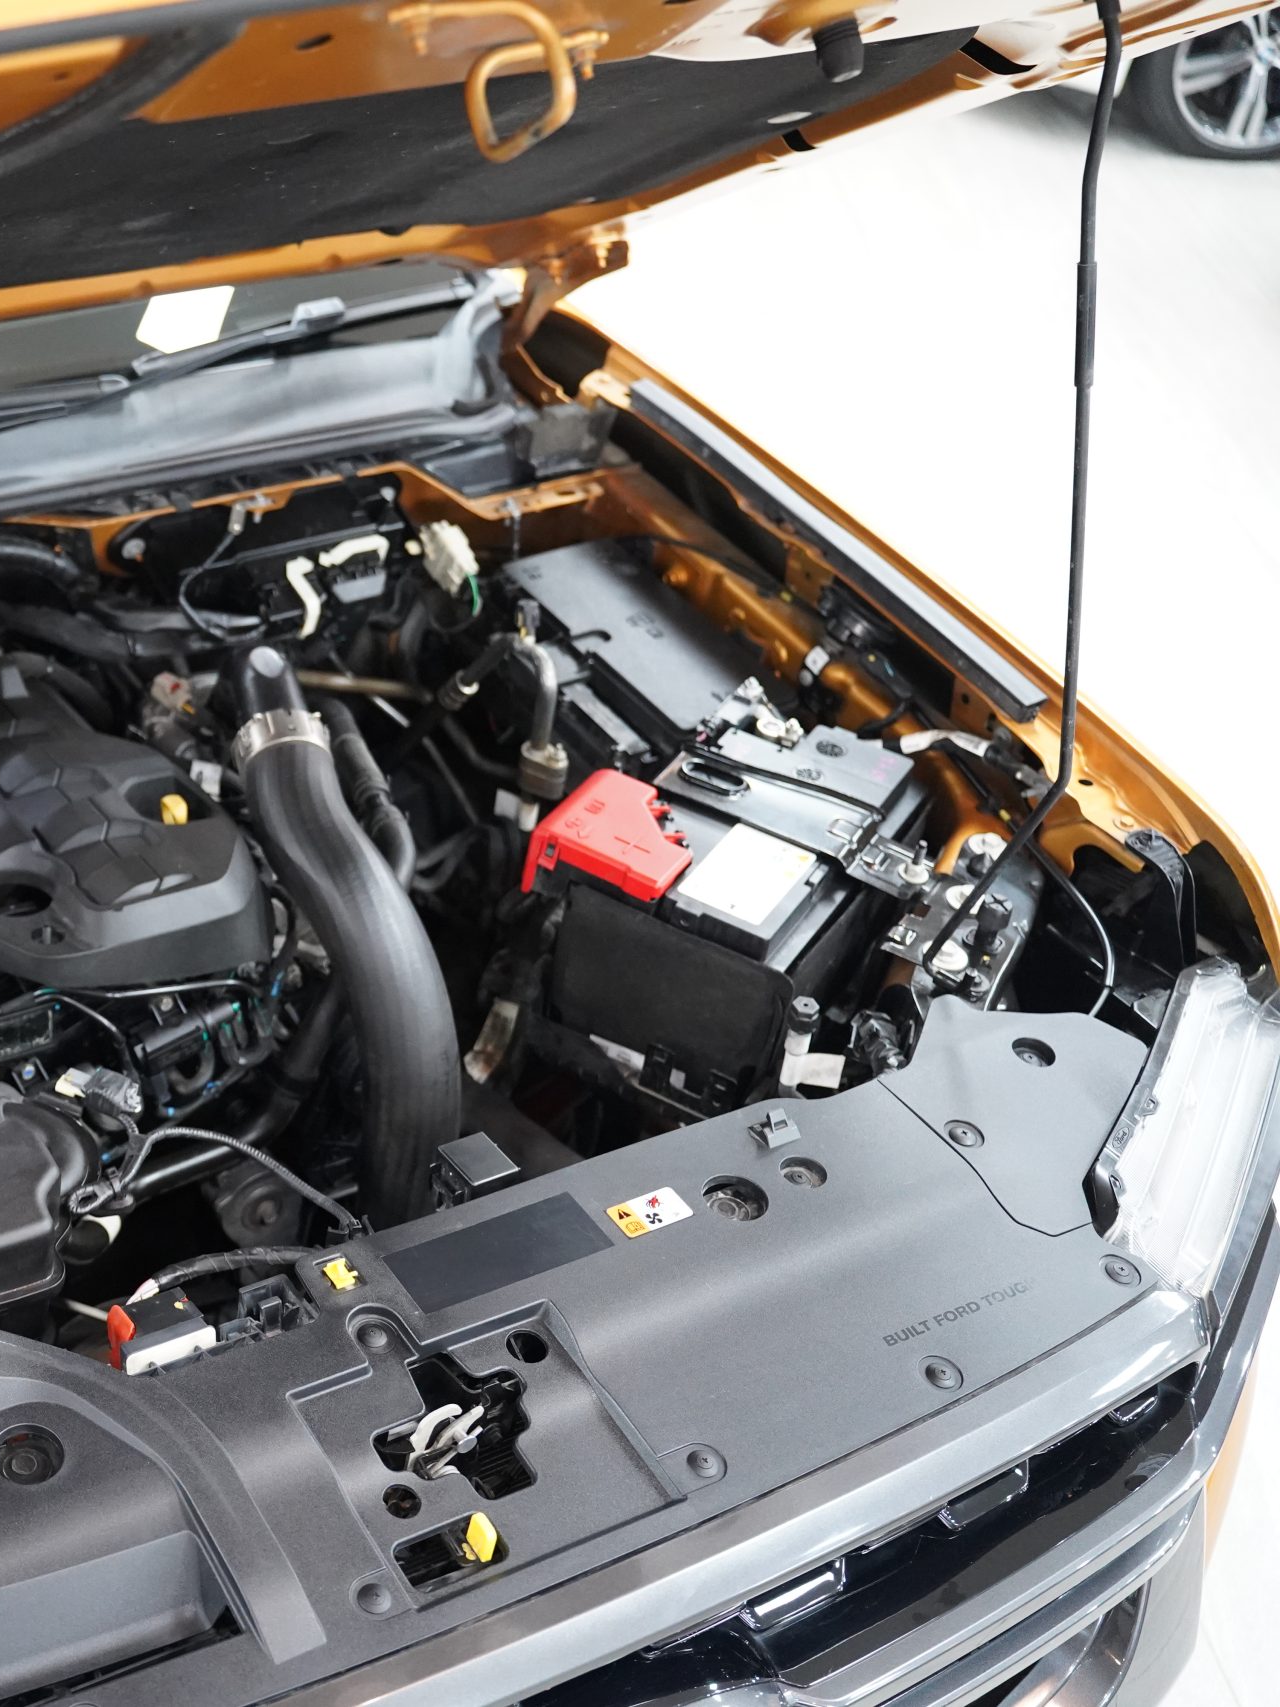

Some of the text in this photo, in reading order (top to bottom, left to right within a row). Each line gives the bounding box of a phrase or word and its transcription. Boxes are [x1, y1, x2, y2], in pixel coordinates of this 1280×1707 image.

[882, 1279, 1033, 1347] BUILT FORD TOUG
